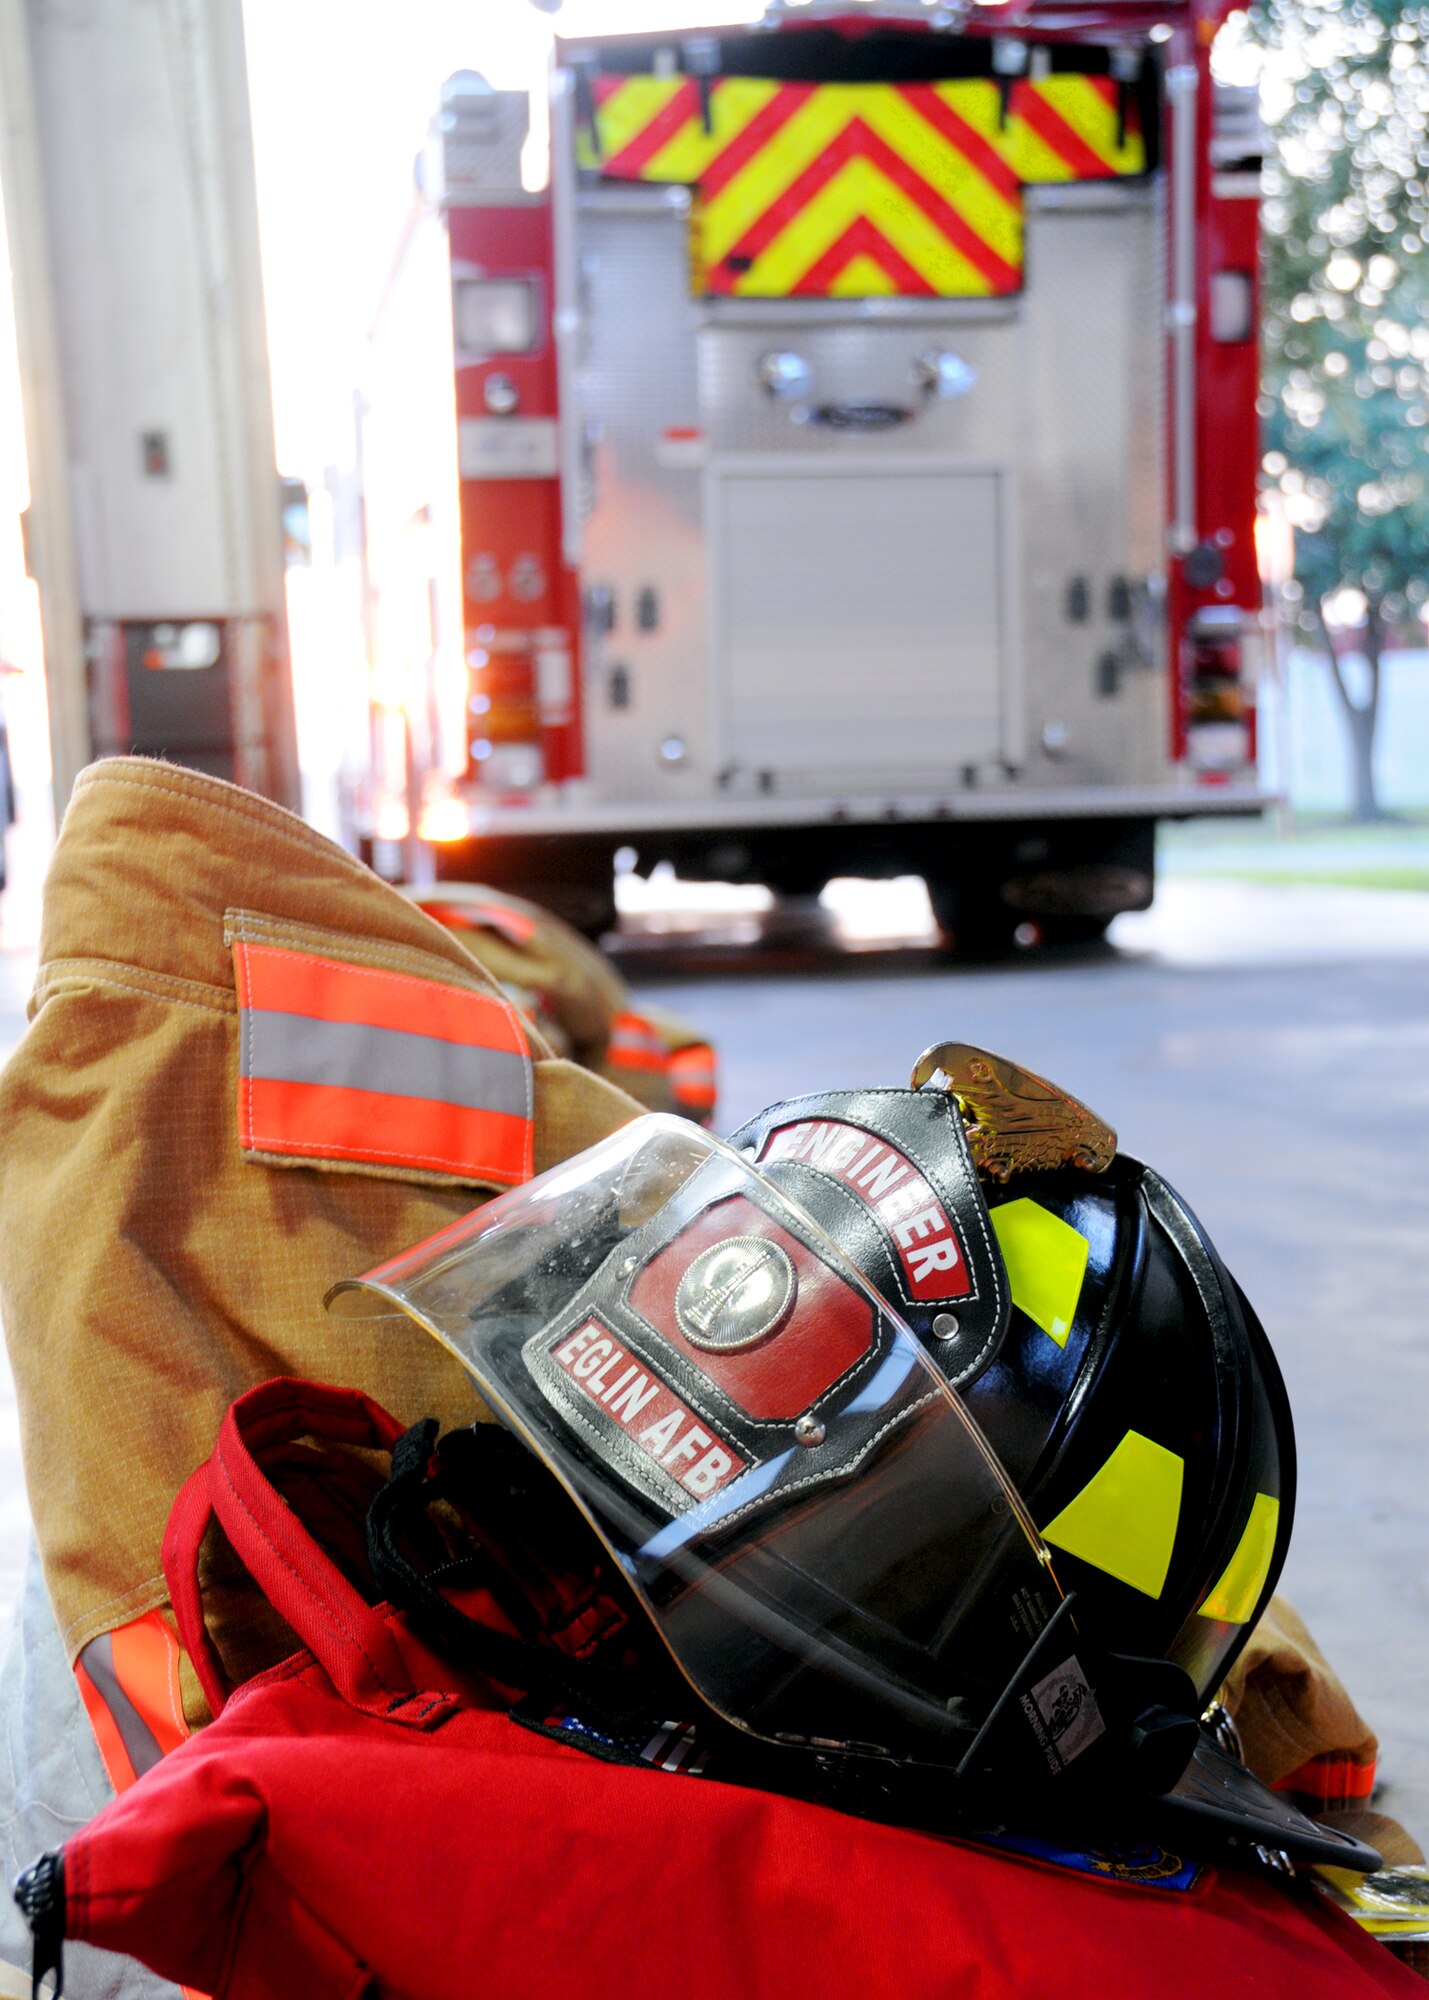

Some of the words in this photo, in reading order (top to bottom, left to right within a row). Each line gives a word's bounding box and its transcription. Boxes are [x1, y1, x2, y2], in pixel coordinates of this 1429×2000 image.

[786, 1122, 958, 1283] ENGINEER
[556, 1324, 660, 1423] EGLIN
[638, 1411, 733, 1496] AFB
[1018, 1693, 1049, 1750] MORNING
[1043, 1745, 1062, 1776] PRIDE
